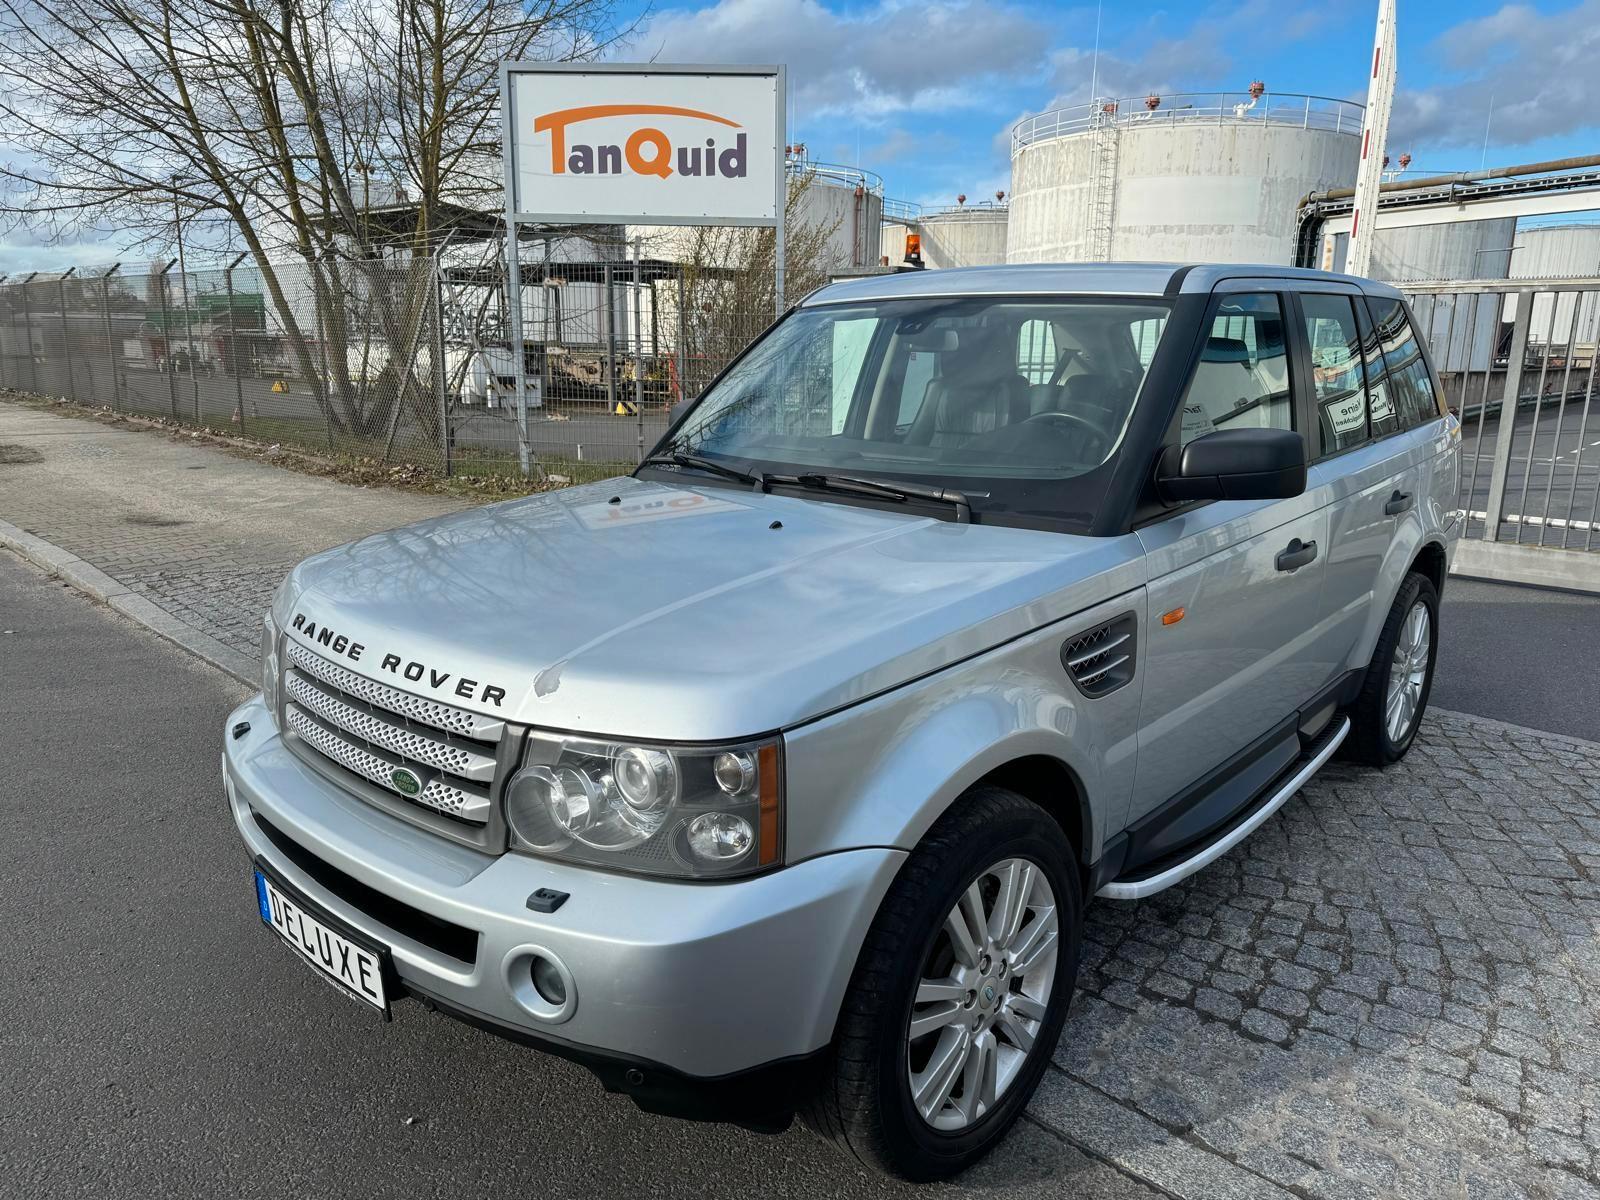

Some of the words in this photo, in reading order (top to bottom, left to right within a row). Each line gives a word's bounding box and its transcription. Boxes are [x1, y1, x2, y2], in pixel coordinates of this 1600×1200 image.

[534, 104, 747, 180] TanQuid
[292, 613, 365, 662] RANGE
[381, 653, 506, 707] ROVER
[268, 888, 378, 999] DELUXE
